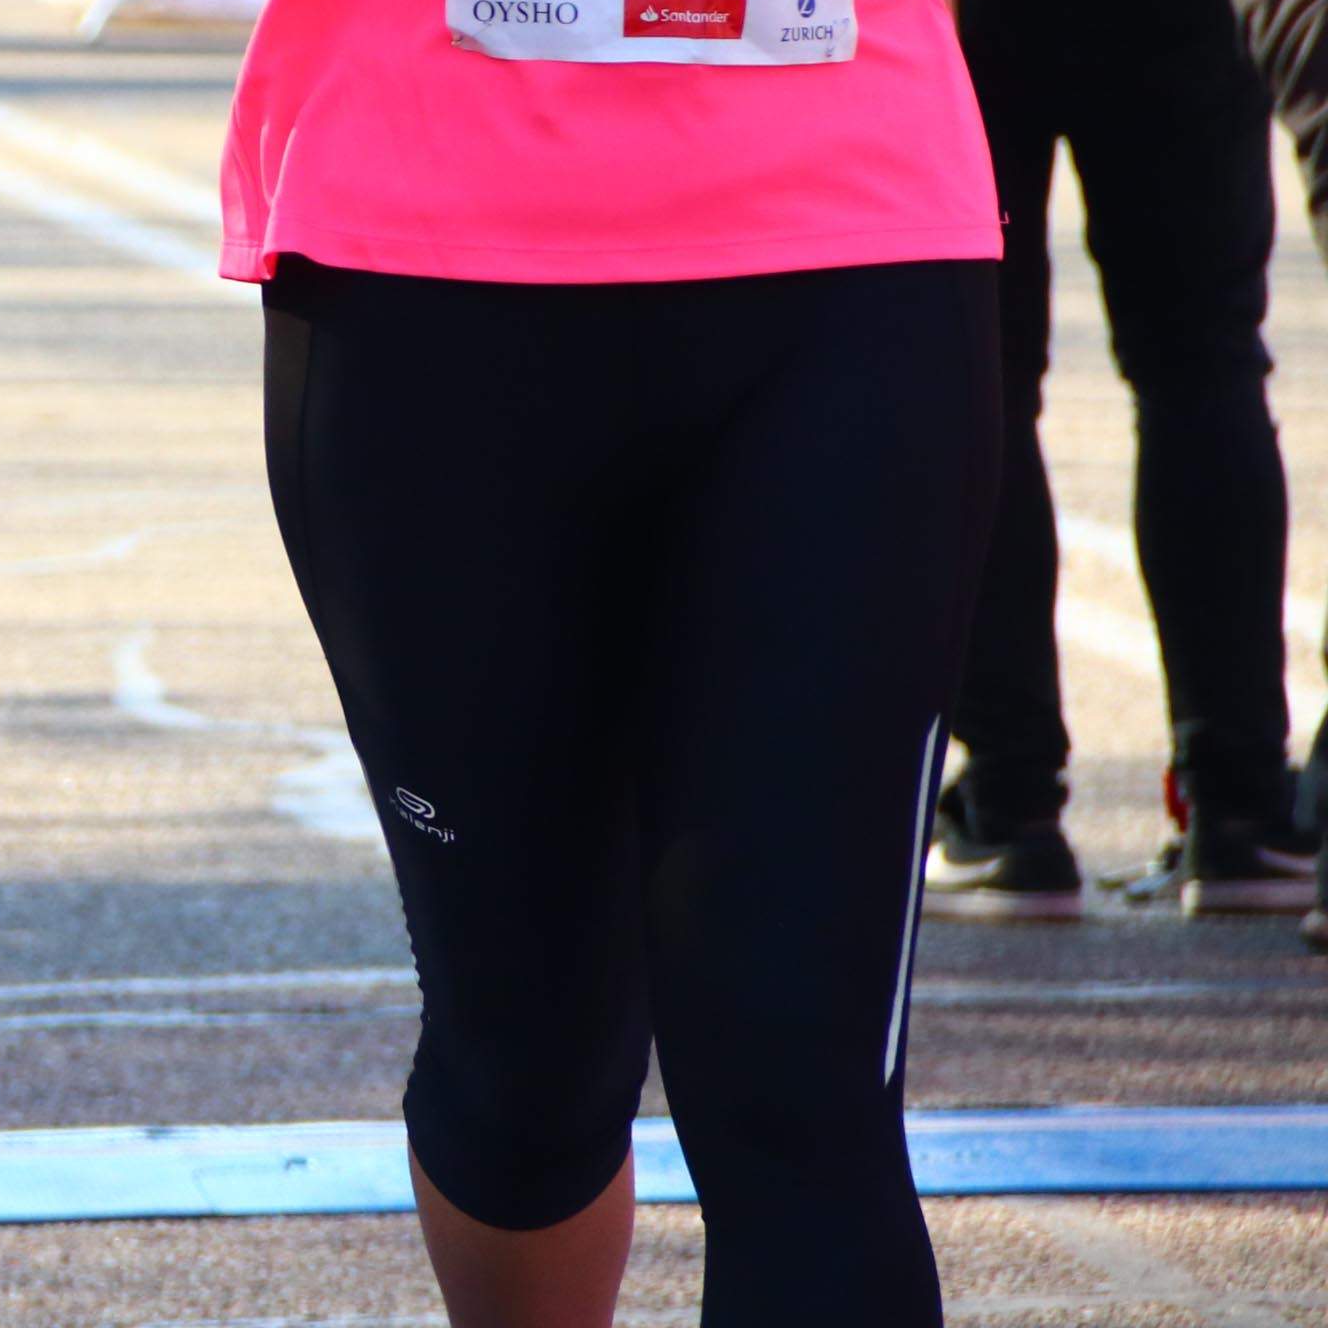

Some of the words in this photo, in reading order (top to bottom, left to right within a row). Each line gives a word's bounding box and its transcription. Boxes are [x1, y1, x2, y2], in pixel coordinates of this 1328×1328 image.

[473, 0, 578, 24] OYSHO
[661, 8, 728, 24] Santander
[781, 25, 834, 42] ZURICH
